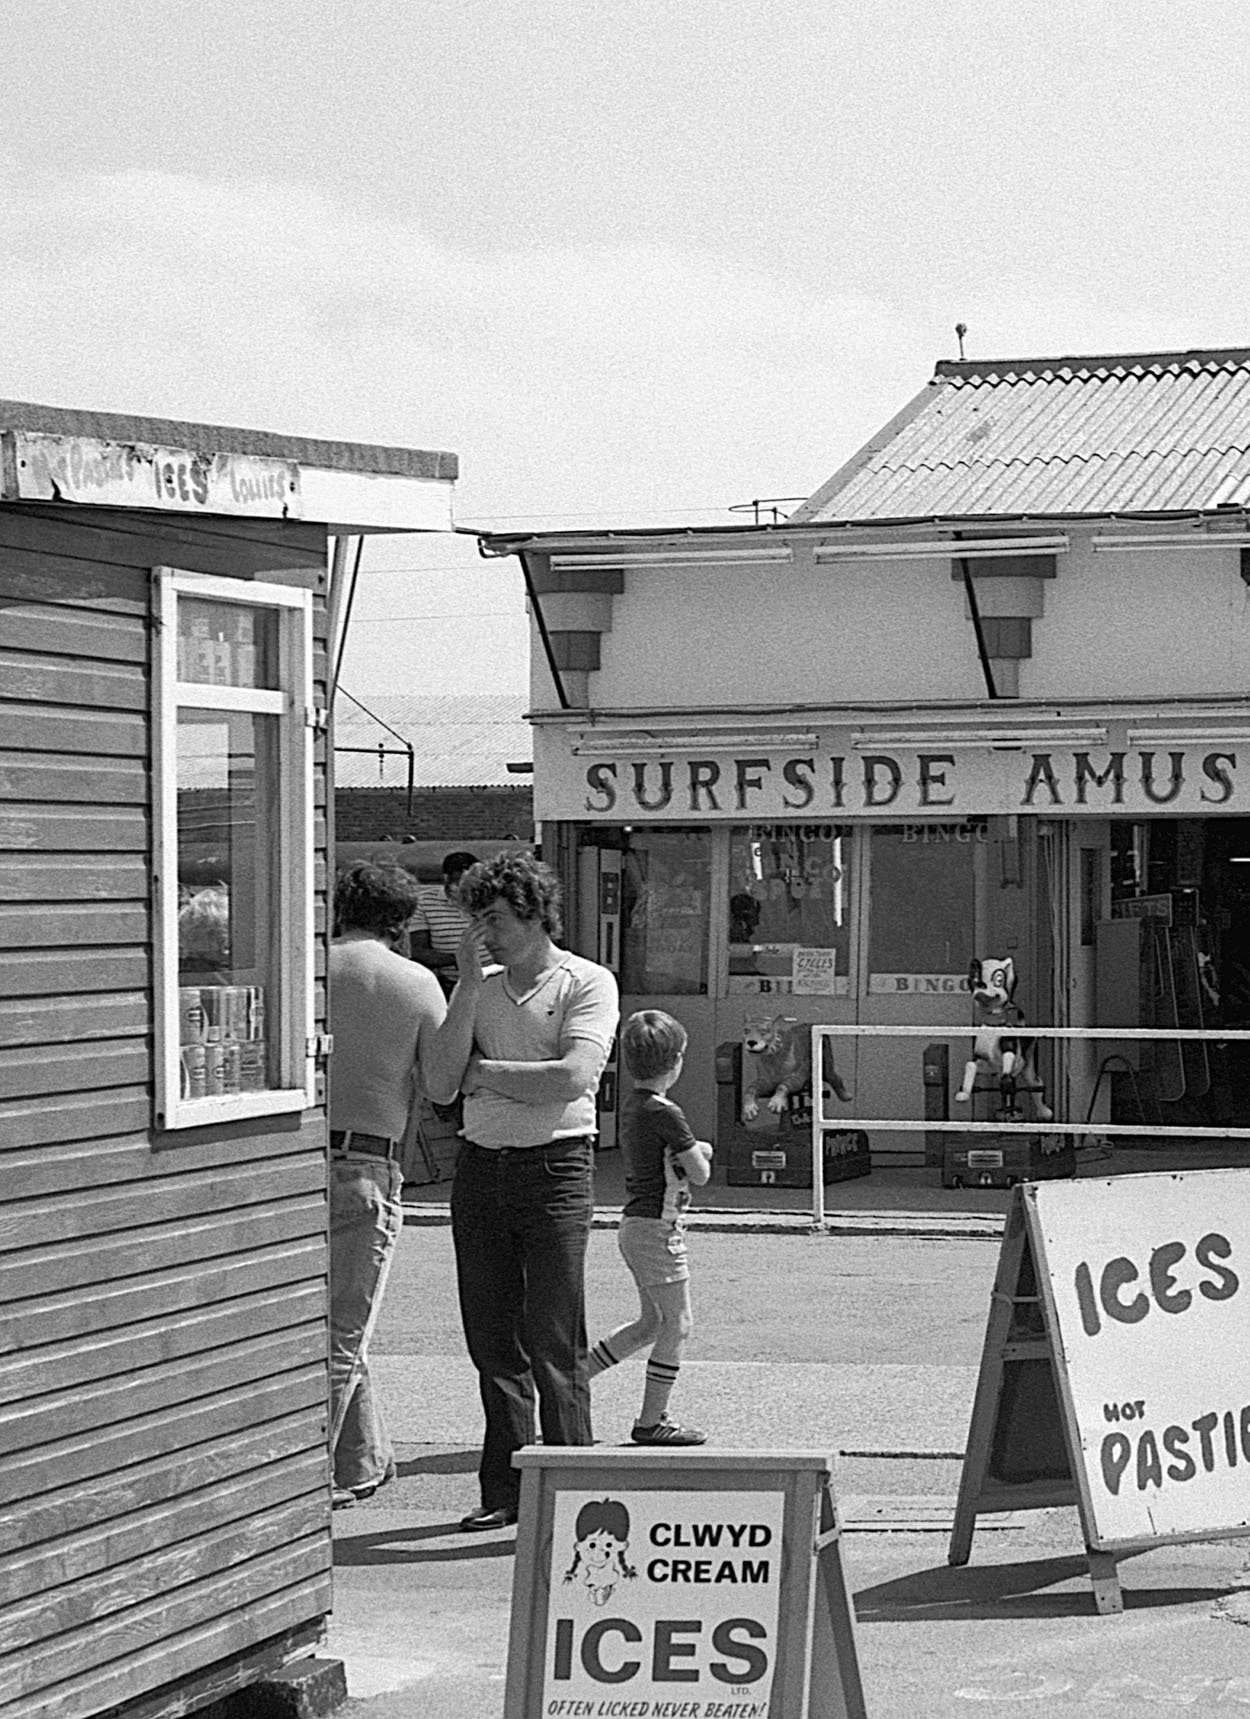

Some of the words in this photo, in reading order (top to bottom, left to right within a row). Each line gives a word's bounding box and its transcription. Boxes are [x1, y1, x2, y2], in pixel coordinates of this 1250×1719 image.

[585, 753, 956, 812] SURFSIDE
[1075, 1232, 1239, 1337] ICES
[1103, 1400, 1145, 1422] HOT
[649, 1522, 772, 1548] CLWYD
[647, 1558, 770, 1583] CREAM
[554, 1617, 769, 1685] ICES
[547, 1699, 594, 1717] OFTEN
[597, 1699, 649, 1717] LICKED
[652, 1700, 701, 1718] NEVER
[705, 1700, 767, 1719] BEATEN!
